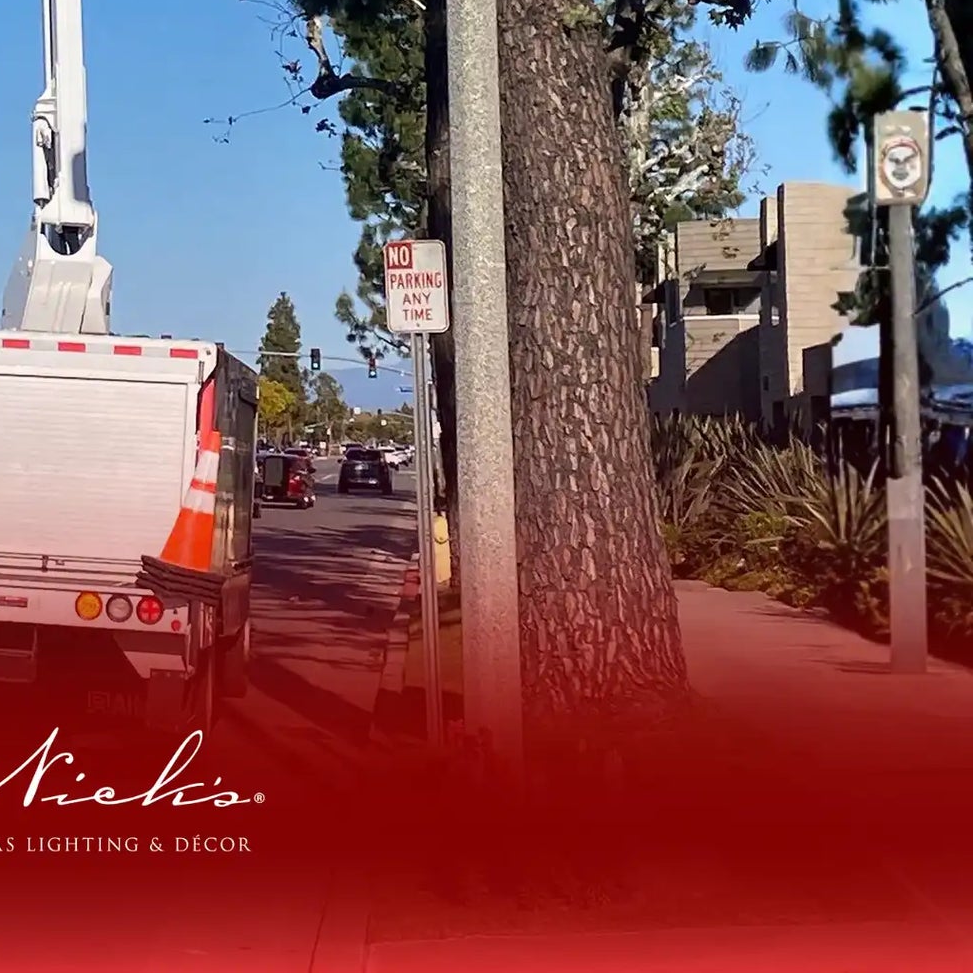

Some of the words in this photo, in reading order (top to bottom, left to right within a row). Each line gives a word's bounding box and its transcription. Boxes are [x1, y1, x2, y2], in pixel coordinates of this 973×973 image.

[388, 245, 410, 267] NO
[389, 272, 442, 289] PARKING
[402, 292, 431, 306] ANY
[402, 308, 433, 321] TIME
